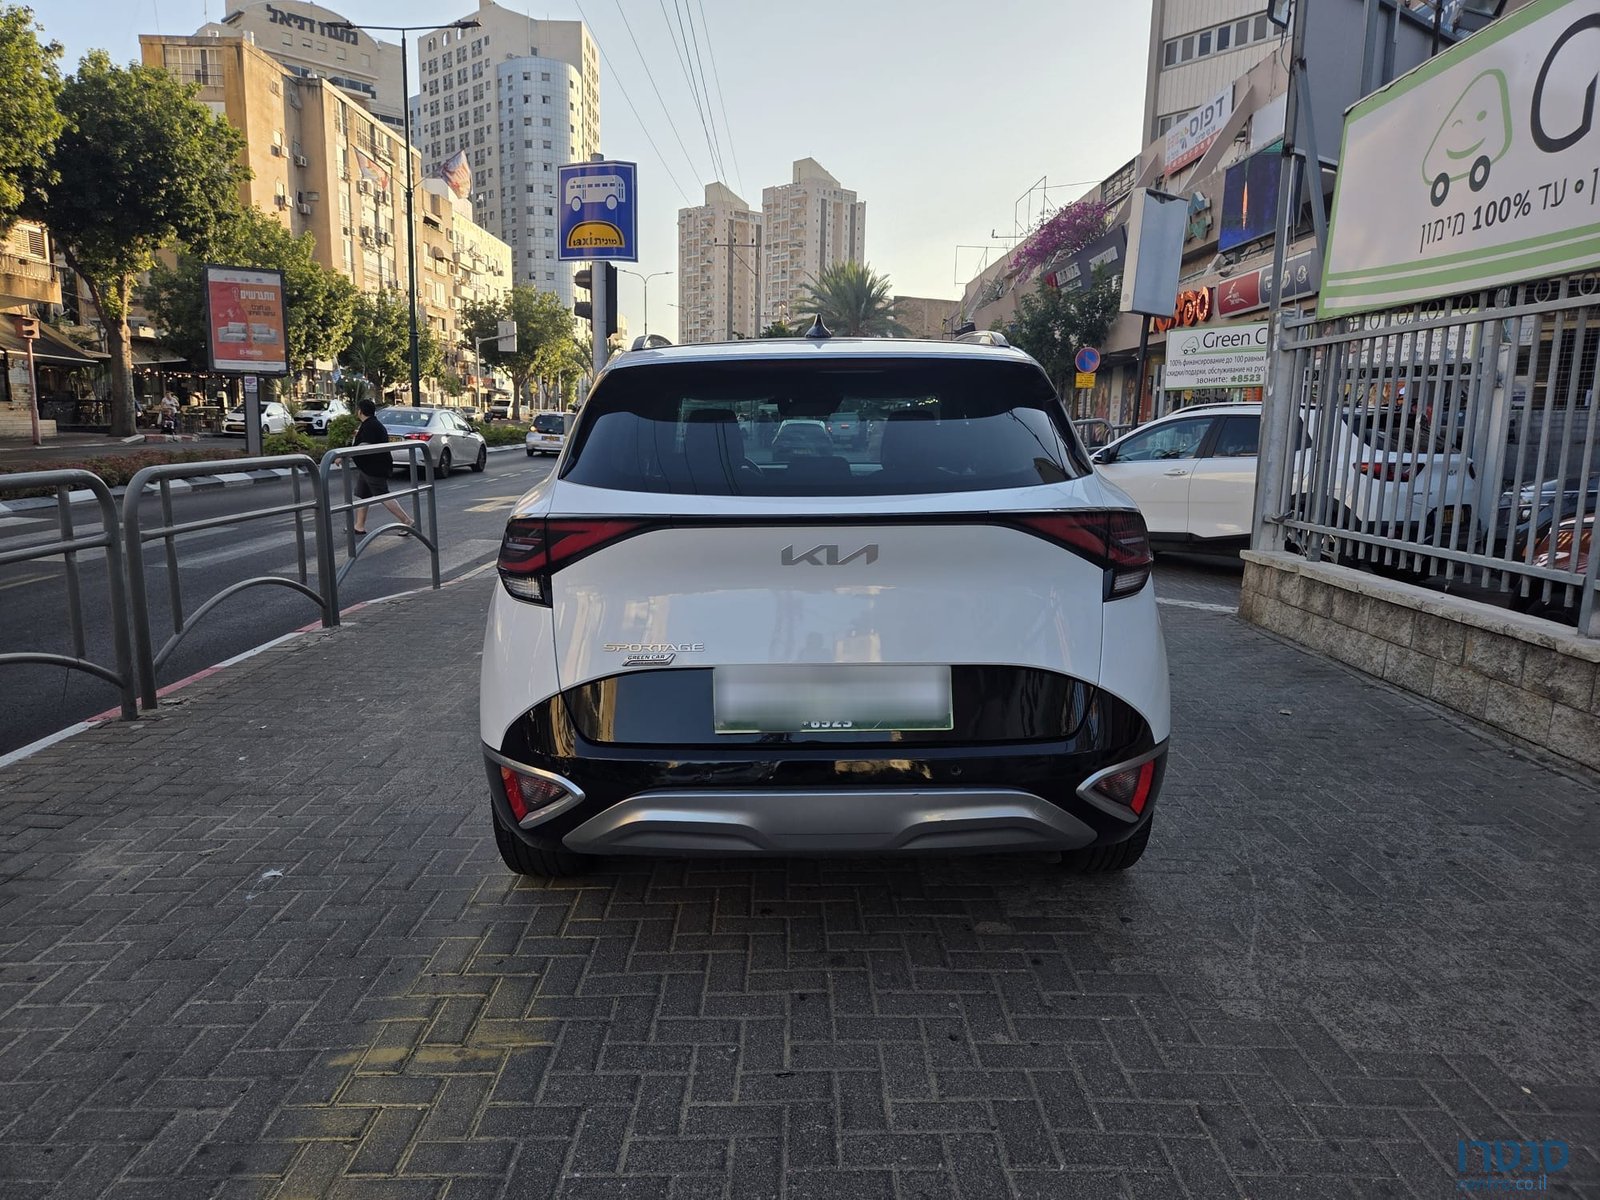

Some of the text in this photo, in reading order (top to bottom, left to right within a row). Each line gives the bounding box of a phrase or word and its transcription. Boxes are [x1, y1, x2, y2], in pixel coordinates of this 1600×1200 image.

[266, 3, 316, 33] דניאל
[1189, 95, 1225, 138] דפוס
[1538, 177, 1567, 210] עד
[1471, 189, 1532, 232] 100%
[573, 232, 618, 246] taxi מונית
[1419, 211, 1467, 254] מימון
[1202, 331, 1251, 349] Green
[1182, 356, 1226, 367] финансирование
[1226, 357, 1233, 365] до
[1234, 355, 1244, 363] 100
[1196, 376, 1228, 384] звоните:
[781, 543, 879, 566] KIA
[603, 642, 705, 653] SPORTAGE
